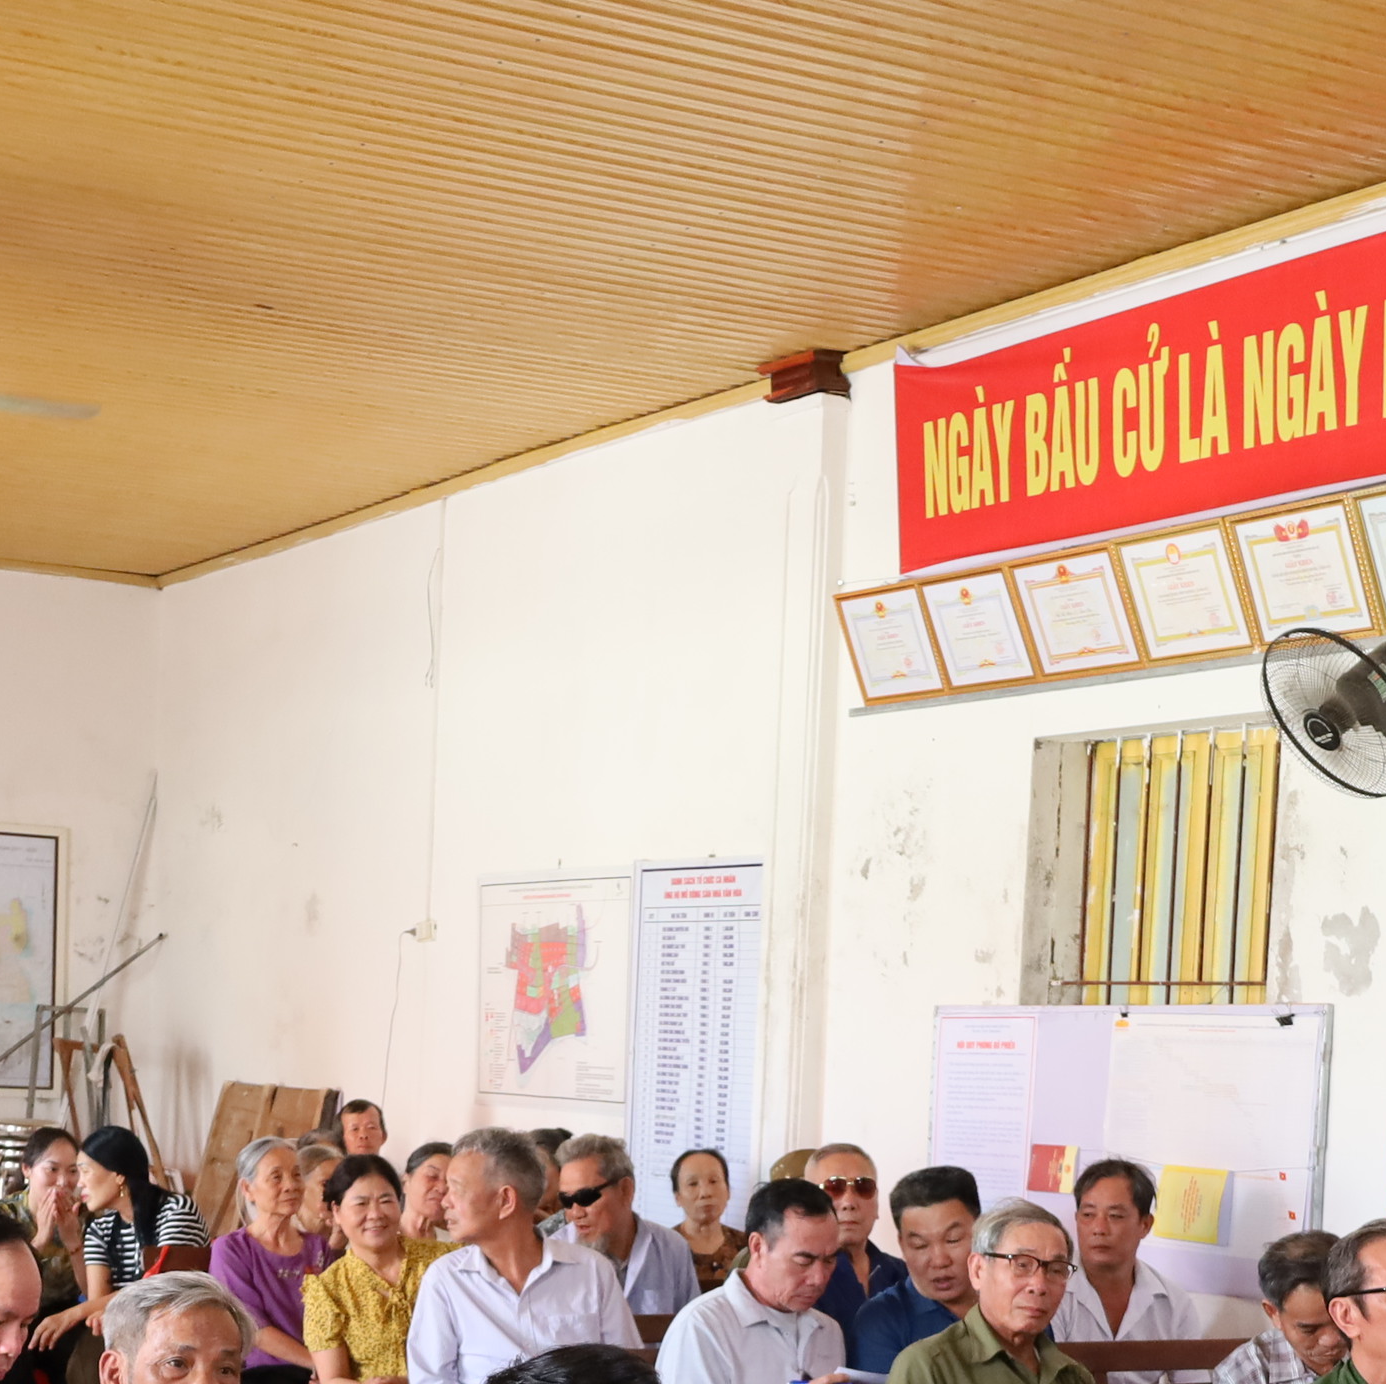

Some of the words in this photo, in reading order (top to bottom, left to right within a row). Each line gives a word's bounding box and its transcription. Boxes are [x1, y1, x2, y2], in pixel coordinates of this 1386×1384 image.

[924, 386, 1015, 518] NGÀY
[1025, 348, 1100, 496] BẦU
[1113, 323, 1170, 477] CỬ
[1179, 321, 1230, 463] LÀ
[1244, 290, 1368, 449] NGÀY
